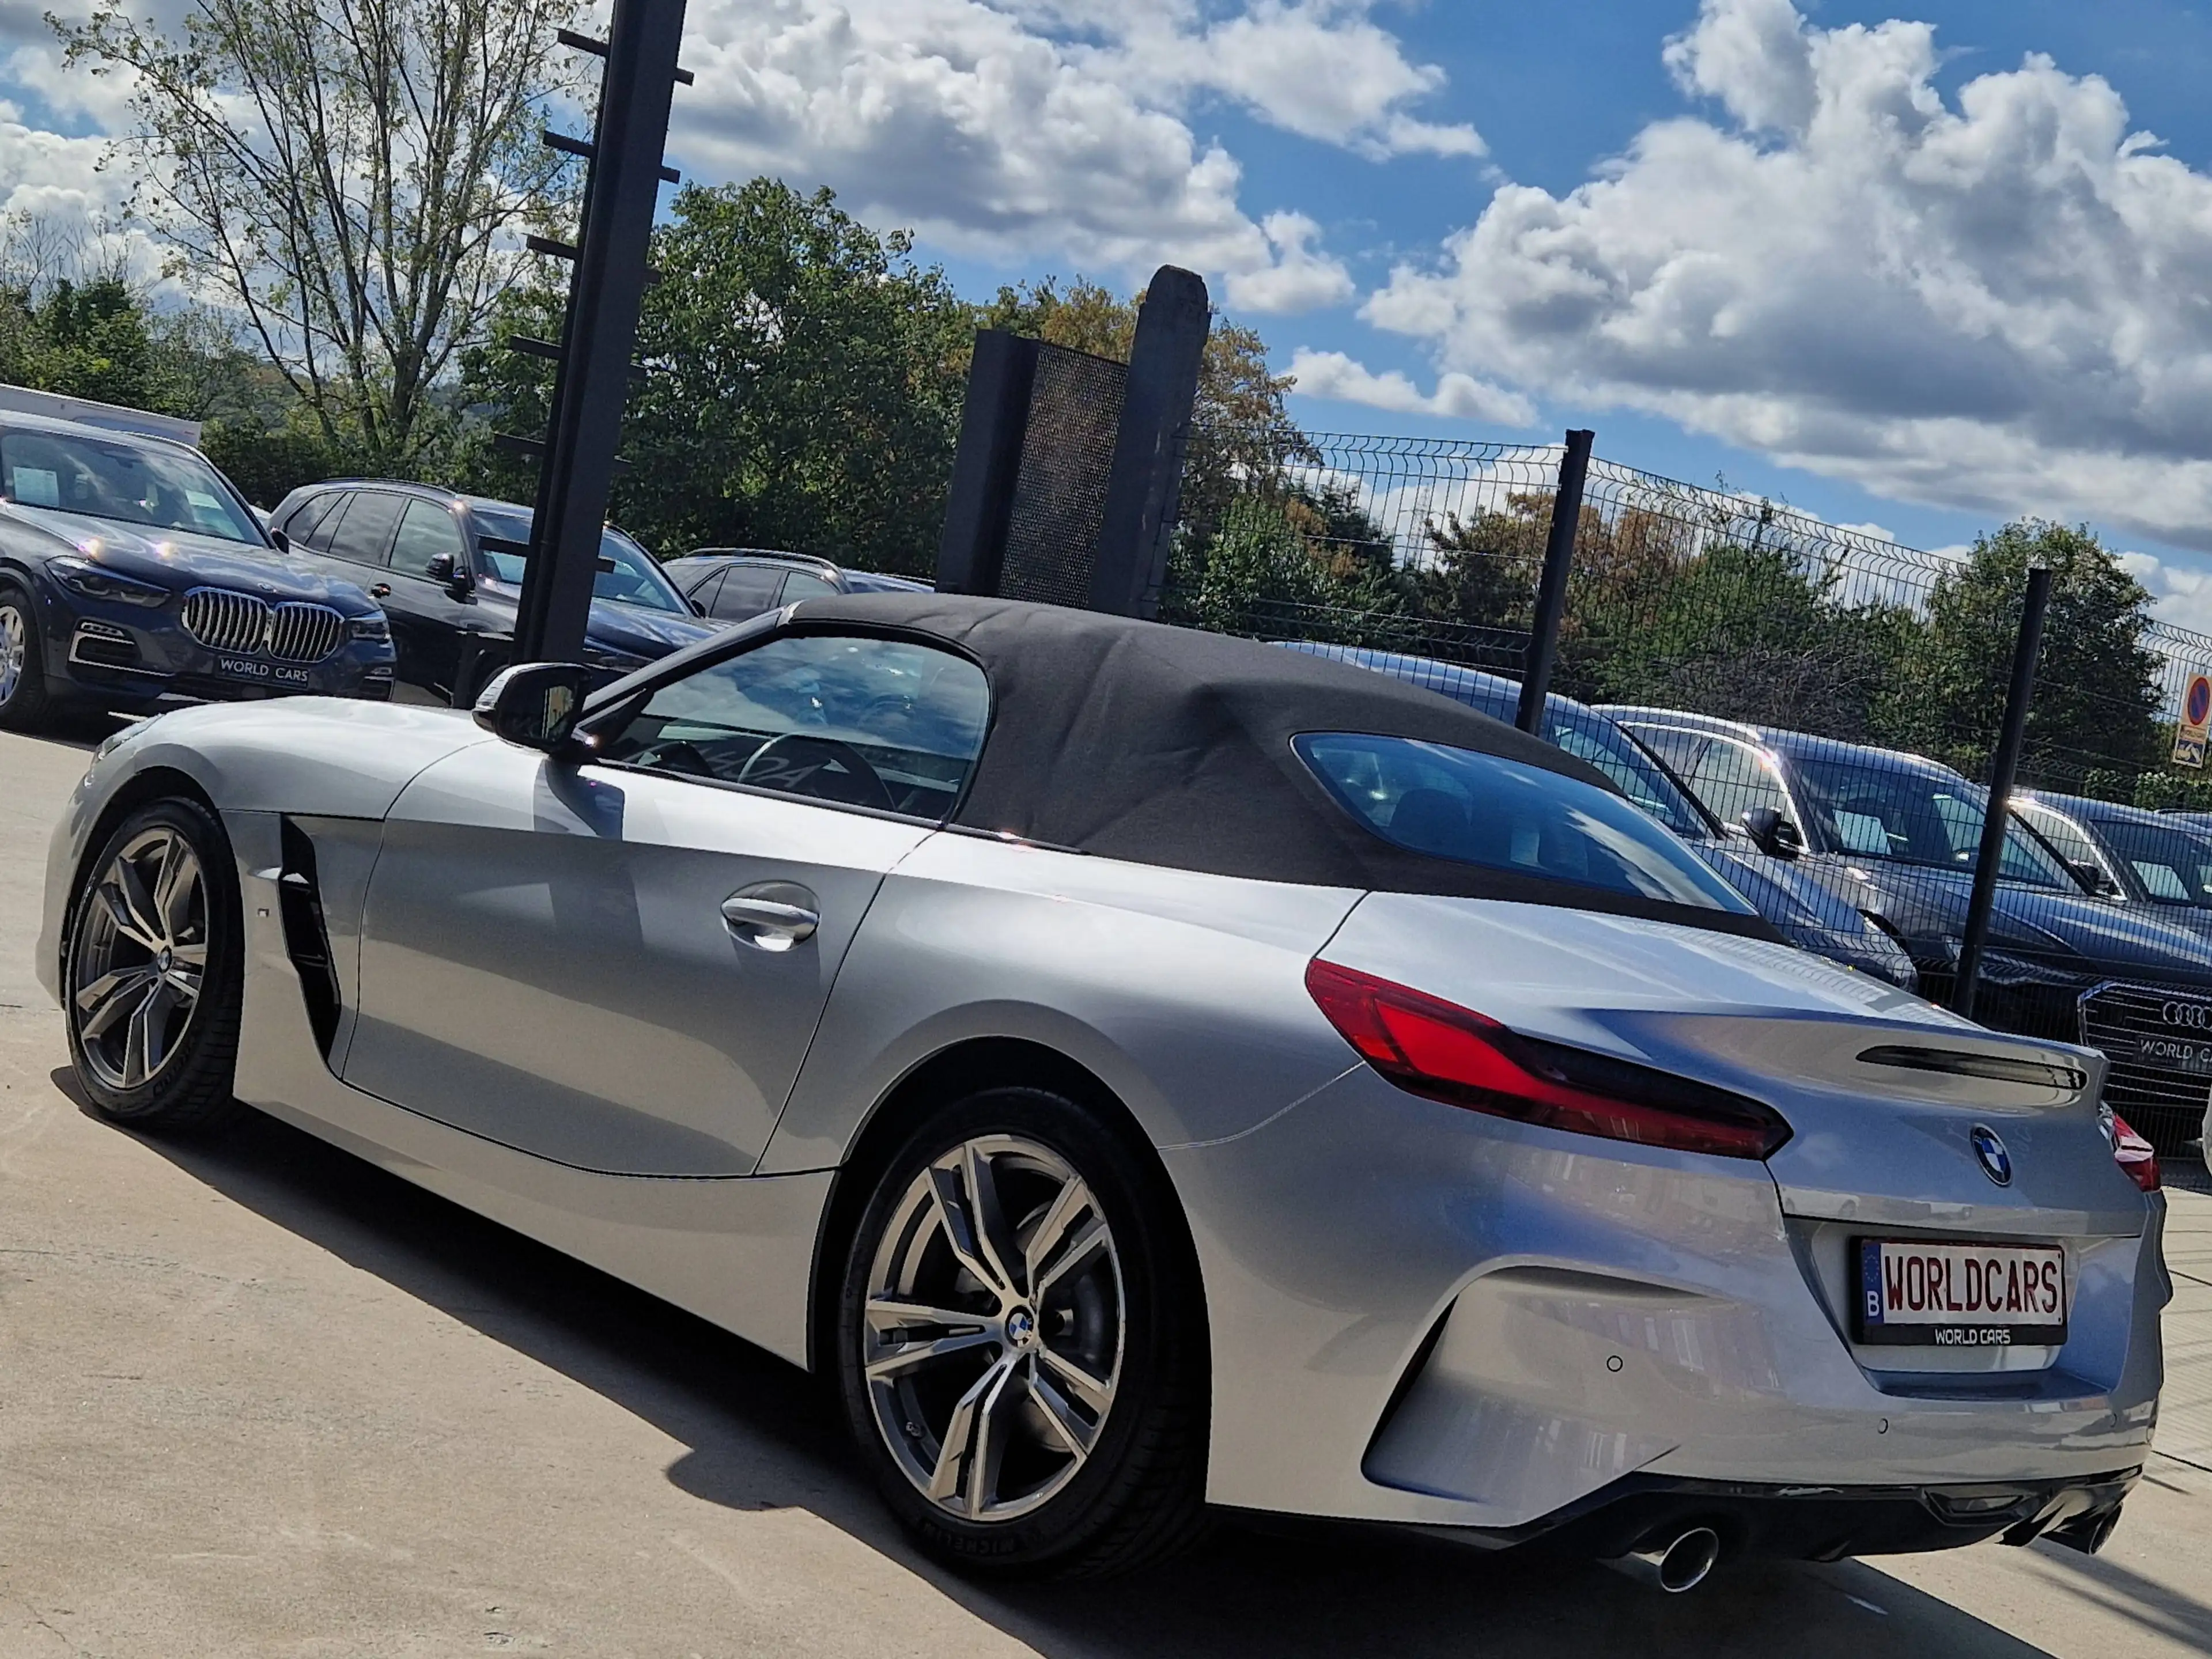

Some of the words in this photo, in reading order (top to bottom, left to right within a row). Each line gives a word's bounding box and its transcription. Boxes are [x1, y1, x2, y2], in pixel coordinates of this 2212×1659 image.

[221, 658, 270, 676] WORLD
[275, 667, 309, 681] CARS
[2141, 1039, 2193, 1059] WORLD
[2200, 1047, 2212, 1062] C
[1885, 1255, 2058, 1313] WORLDCARS
[1867, 1290, 1880, 1317] B
[1935, 1328, 1977, 1345] WORLD
[1980, 1328, 2011, 1345] CARS
